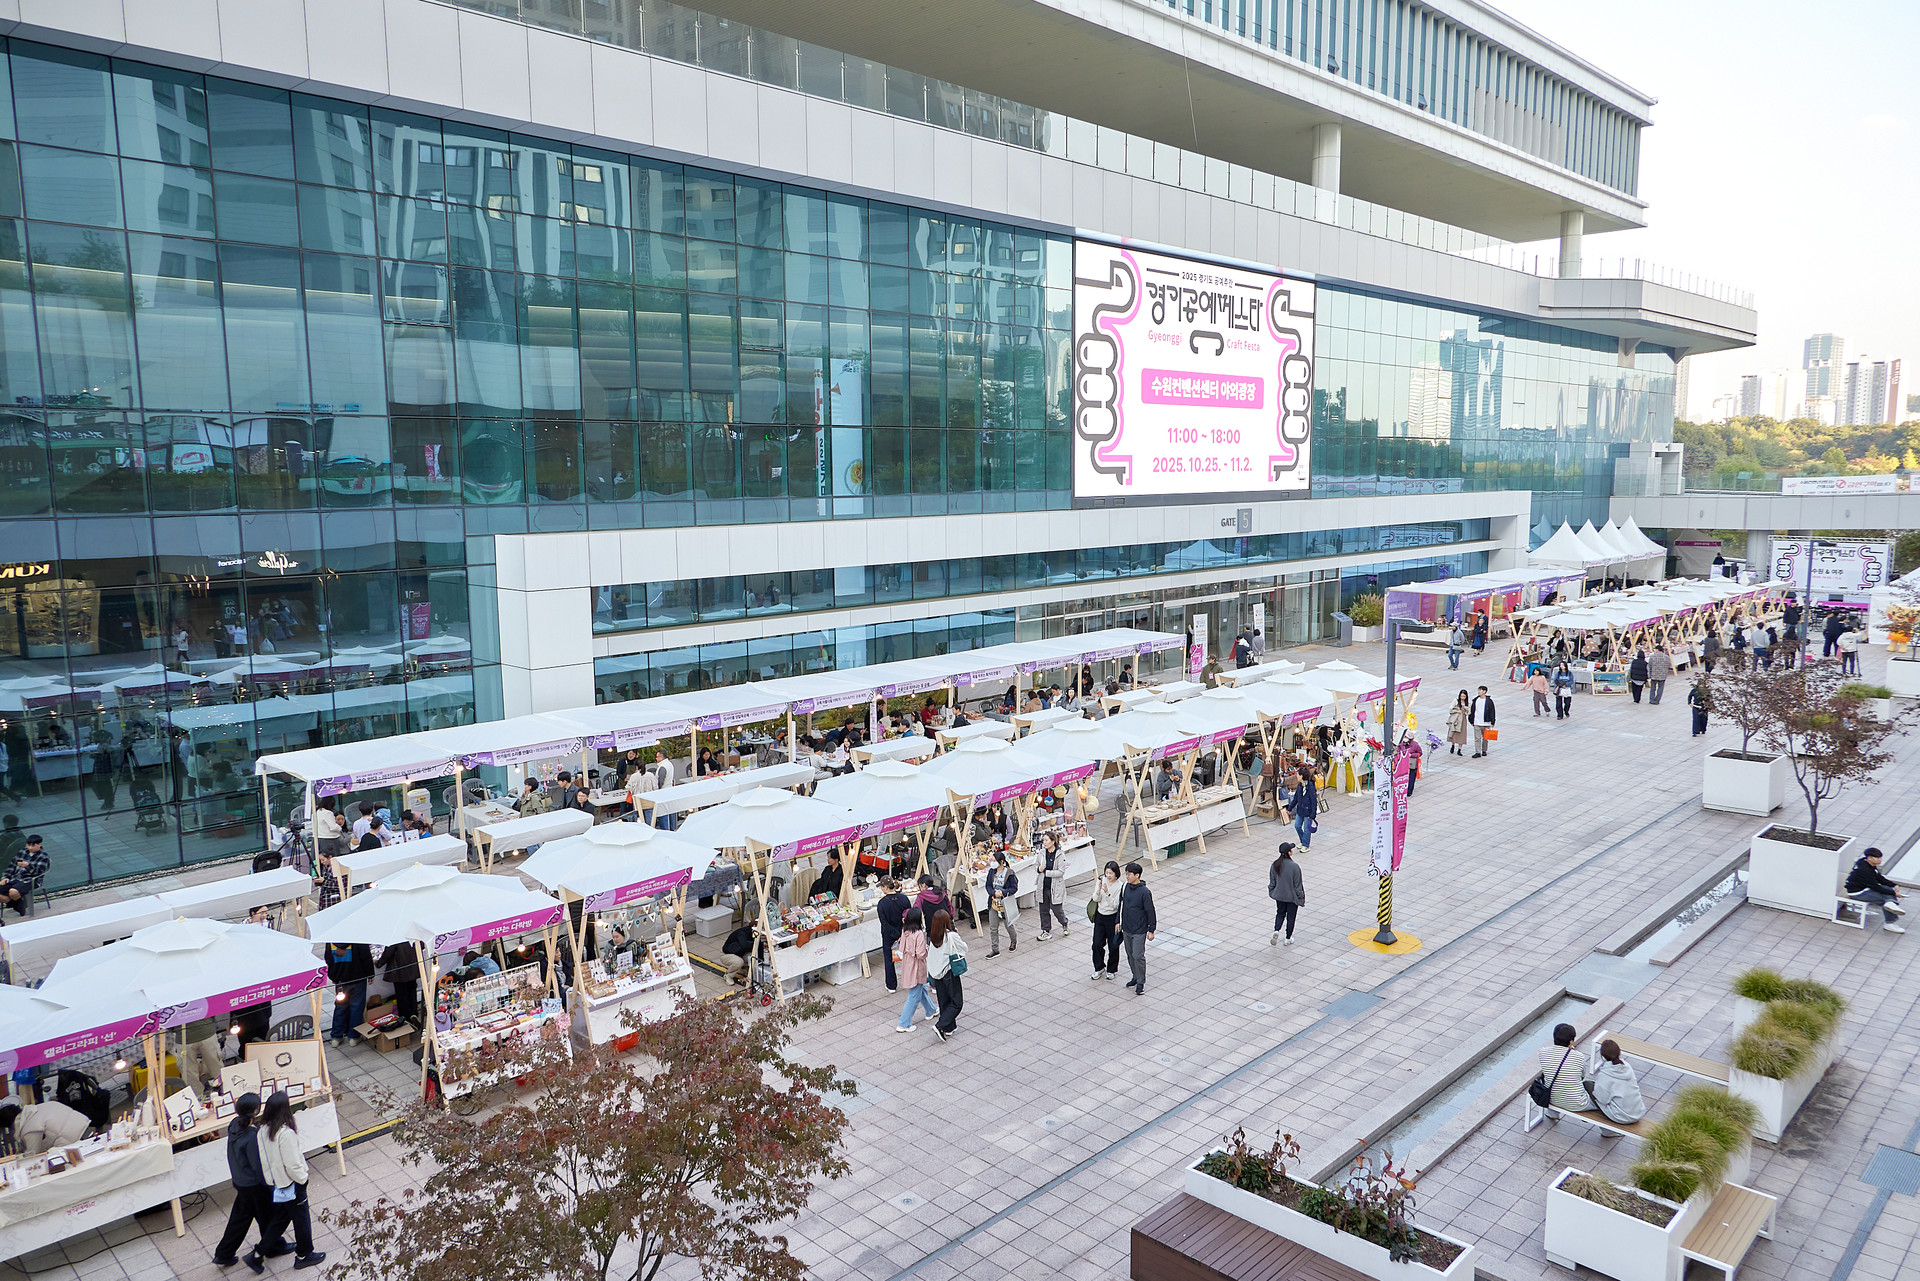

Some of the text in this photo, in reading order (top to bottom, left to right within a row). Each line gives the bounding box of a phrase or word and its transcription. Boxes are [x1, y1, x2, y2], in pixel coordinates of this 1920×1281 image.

[1182, 272, 1197, 280] 2025
[1146, 282, 1264, 332] 경기공예페스타
[1148, 330, 1260, 352] Gyeonggi Craft Festa
[1152, 376, 1256, 402] 수원컨벤션센터 야외광장
[1168, 428, 1198, 444] 11:00
[1210, 429, 1240, 444] 18:00
[1221, 512, 1248, 528] GATE 5
[488, 919, 532, 937] 꿈꾸는 다락방
[229, 988, 276, 1007] 캘리그라피
[44, 1037, 98, 1058] 캘리그라피
